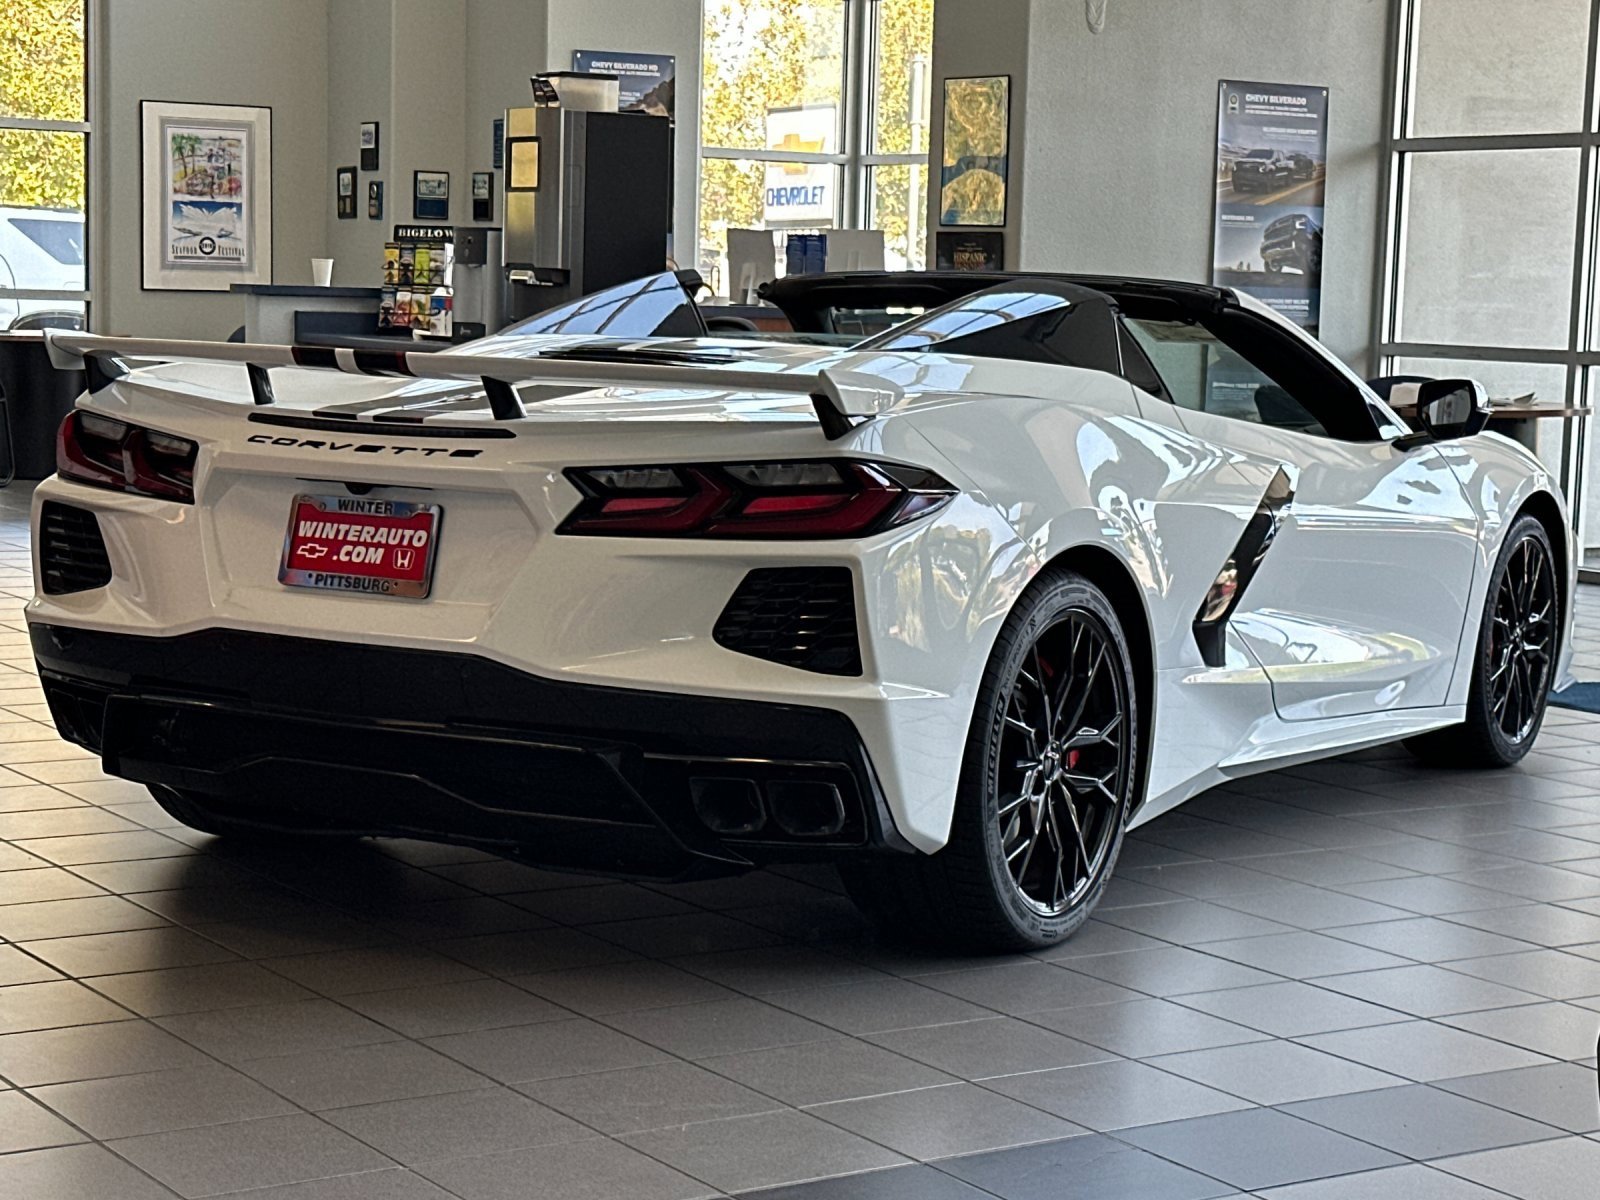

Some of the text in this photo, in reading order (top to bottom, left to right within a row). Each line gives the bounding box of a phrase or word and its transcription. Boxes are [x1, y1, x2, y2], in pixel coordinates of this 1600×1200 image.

[591, 60, 613, 69] CHEVY
[613, 62, 648, 71] SILVERADO
[1245, 93, 1307, 106] CHEVY SILVERADO
[766, 186, 825, 206] CHEVROLET
[398, 228, 454, 237] BIGELOW
[171, 244, 198, 255] SEAFOOD
[217, 245, 246, 257] FESTIVAL
[953, 252, 987, 262] HISPANIC
[247, 434, 484, 458] CORVETTE
[337, 499, 394, 515] WINTER
[298, 520, 428, 548] WINTERAUTO
[332, 545, 385, 565] .COM
[314, 573, 391, 592] PITTSBURG
[987, 697, 1004, 795] MICHELIN
